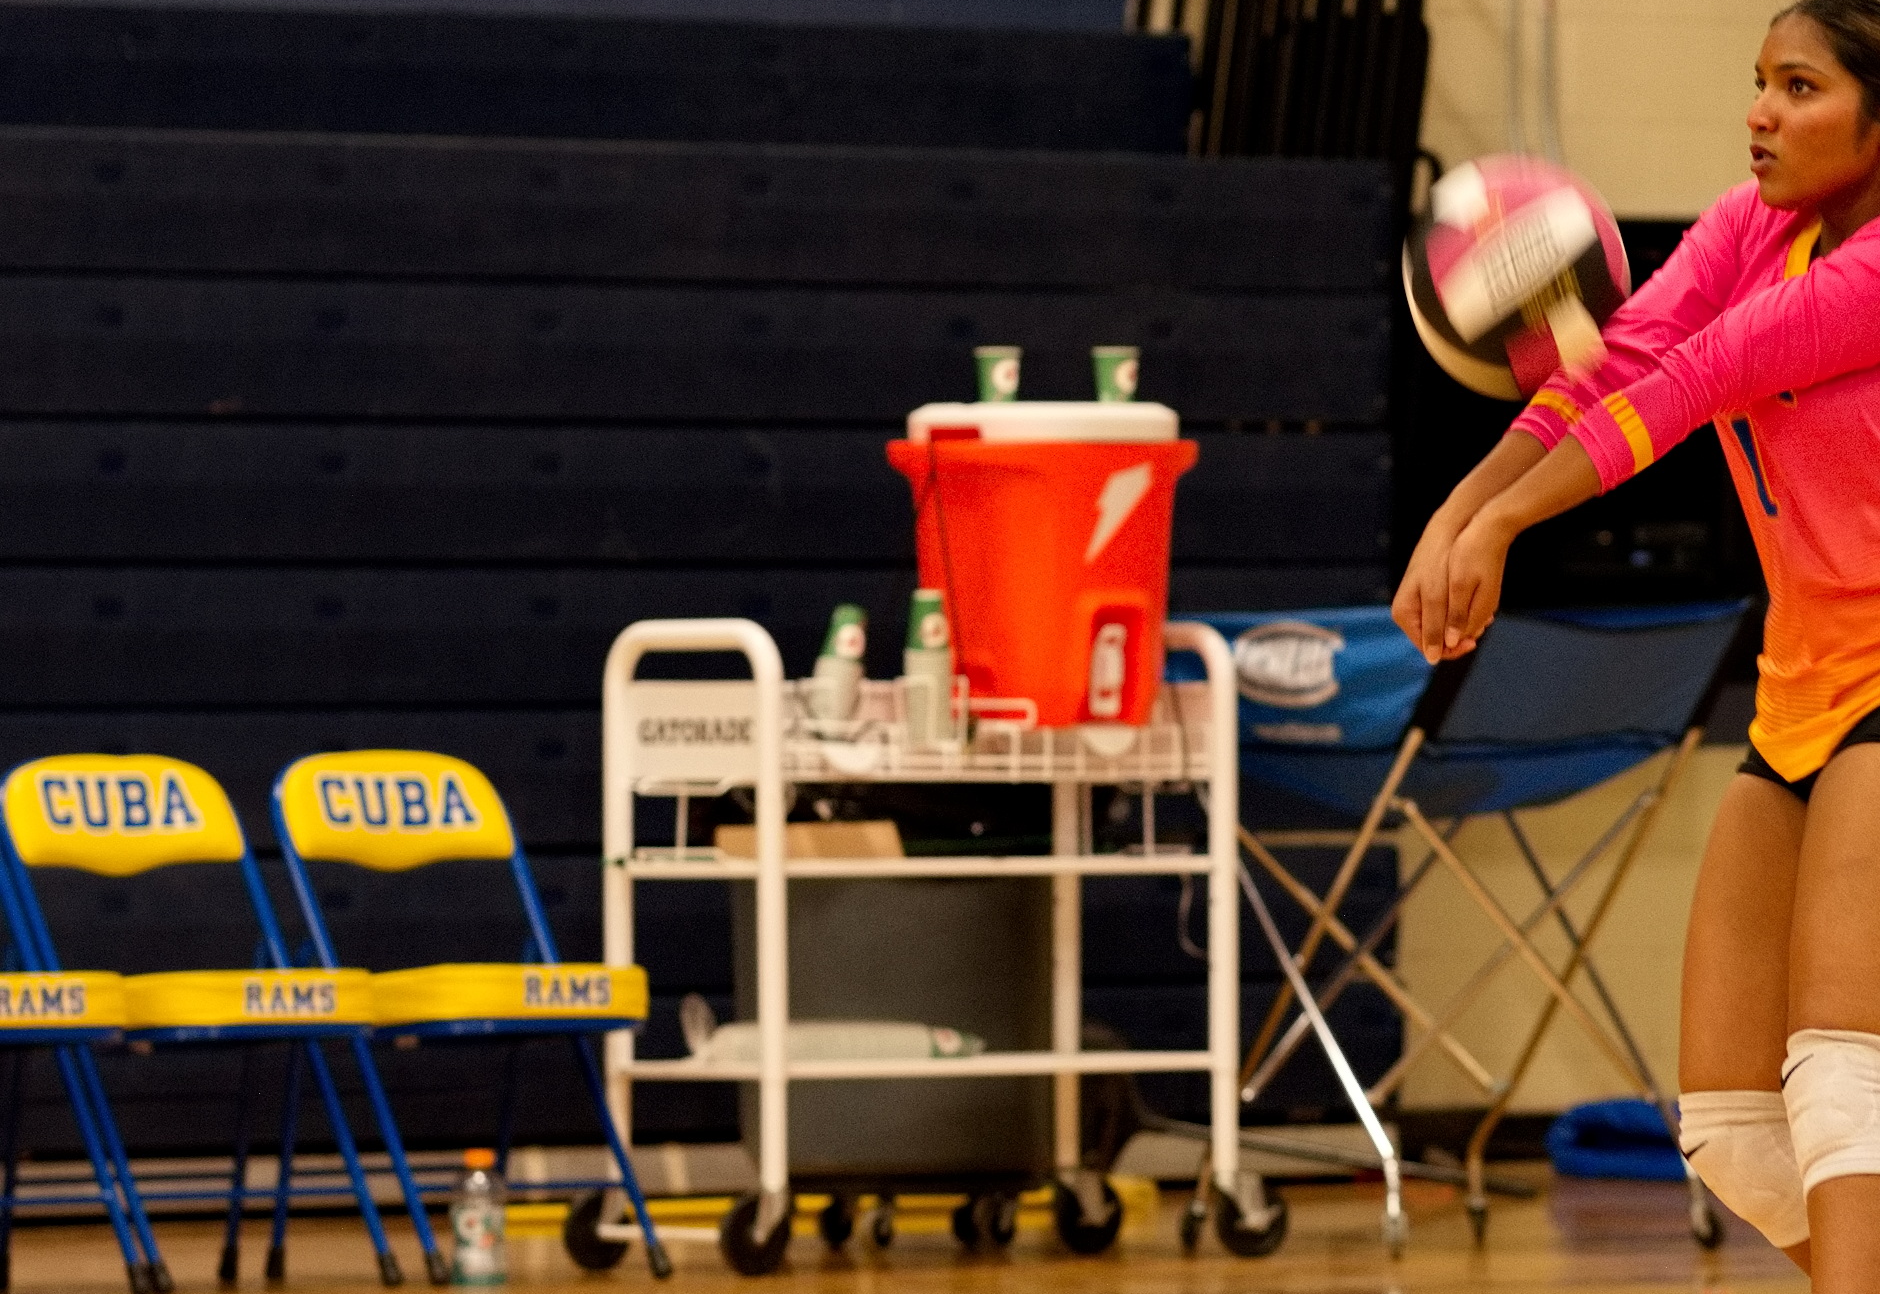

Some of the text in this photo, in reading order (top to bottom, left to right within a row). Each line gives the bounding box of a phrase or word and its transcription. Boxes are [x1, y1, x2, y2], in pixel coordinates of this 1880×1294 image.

[638, 716, 754, 746] GATORADE
[40, 775, 198, 831] CUBA
[317, 775, 477, 830] CUBA
[244, 982, 336, 1015] RAMS
[524, 974, 611, 1007] RAMS
